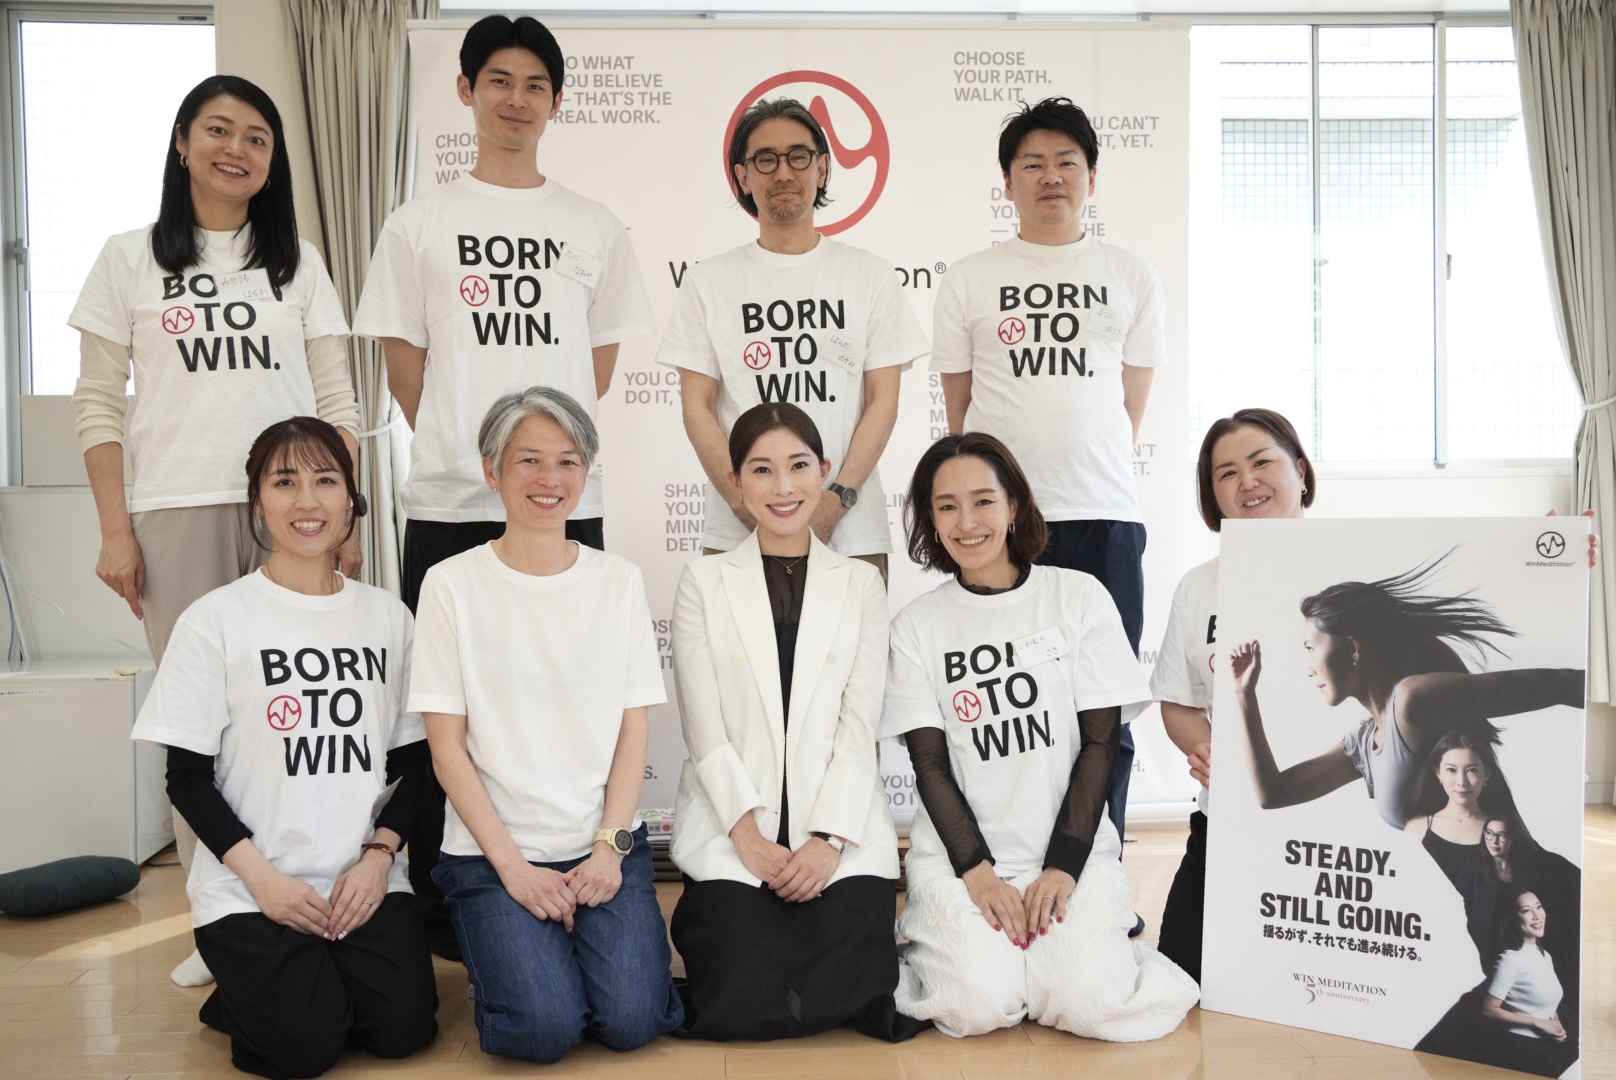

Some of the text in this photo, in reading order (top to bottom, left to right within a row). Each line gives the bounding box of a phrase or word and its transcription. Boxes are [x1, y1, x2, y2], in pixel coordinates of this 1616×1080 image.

[565, 56, 635, 70] O WHAT
[954, 51, 1026, 65] CHOOSE
[563, 74, 663, 88] OU BELIEVE
[954, 70, 1052, 84] YOUR PATH.
[574, 91, 673, 106] THAT'S THE
[954, 88, 1004, 102] WALK
[553, 109, 661, 124] REAL WORK.
[1108, 115, 1160, 130] CAN'T
[435, 132, 478, 149] CHO
[1120, 134, 1154, 148] YET.
[457, 235, 566, 270] BORN
[489, 273, 542, 308] TO
[1000, 283, 1108, 312] BORN
[194, 302, 257, 331] TO
[472, 312, 560, 346] WIN.
[741, 299, 845, 334] BORN
[1026, 312, 1080, 343] TO
[176, 335, 280, 372] WIN.
[771, 333, 817, 368] TO
[1009, 347, 1094, 377] WIN.
[624, 372, 660, 386] YOU
[755, 371, 836, 404] WIN.
[625, 390, 673, 406] DO IT,
[665, 520, 705, 534] MIN
[260, 647, 387, 687] BORN
[302, 687, 363, 728] TO
[976, 672, 1038, 716] TO
[971, 710, 1055, 762] WIN.
[283, 734, 372, 776] WIN
[881, 774, 915, 788] YOU
[1285, 839, 1396, 877] STEADY.
[1314, 872, 1373, 903] AND
[1260, 892, 1431, 941] STILL GOING.
[1263, 924, 1422, 962] 揺るがず、それでも進み続ける。
[1293, 973, 1387, 997] WIN MEDITATION
[1326, 991, 1371, 1006] anniversary
